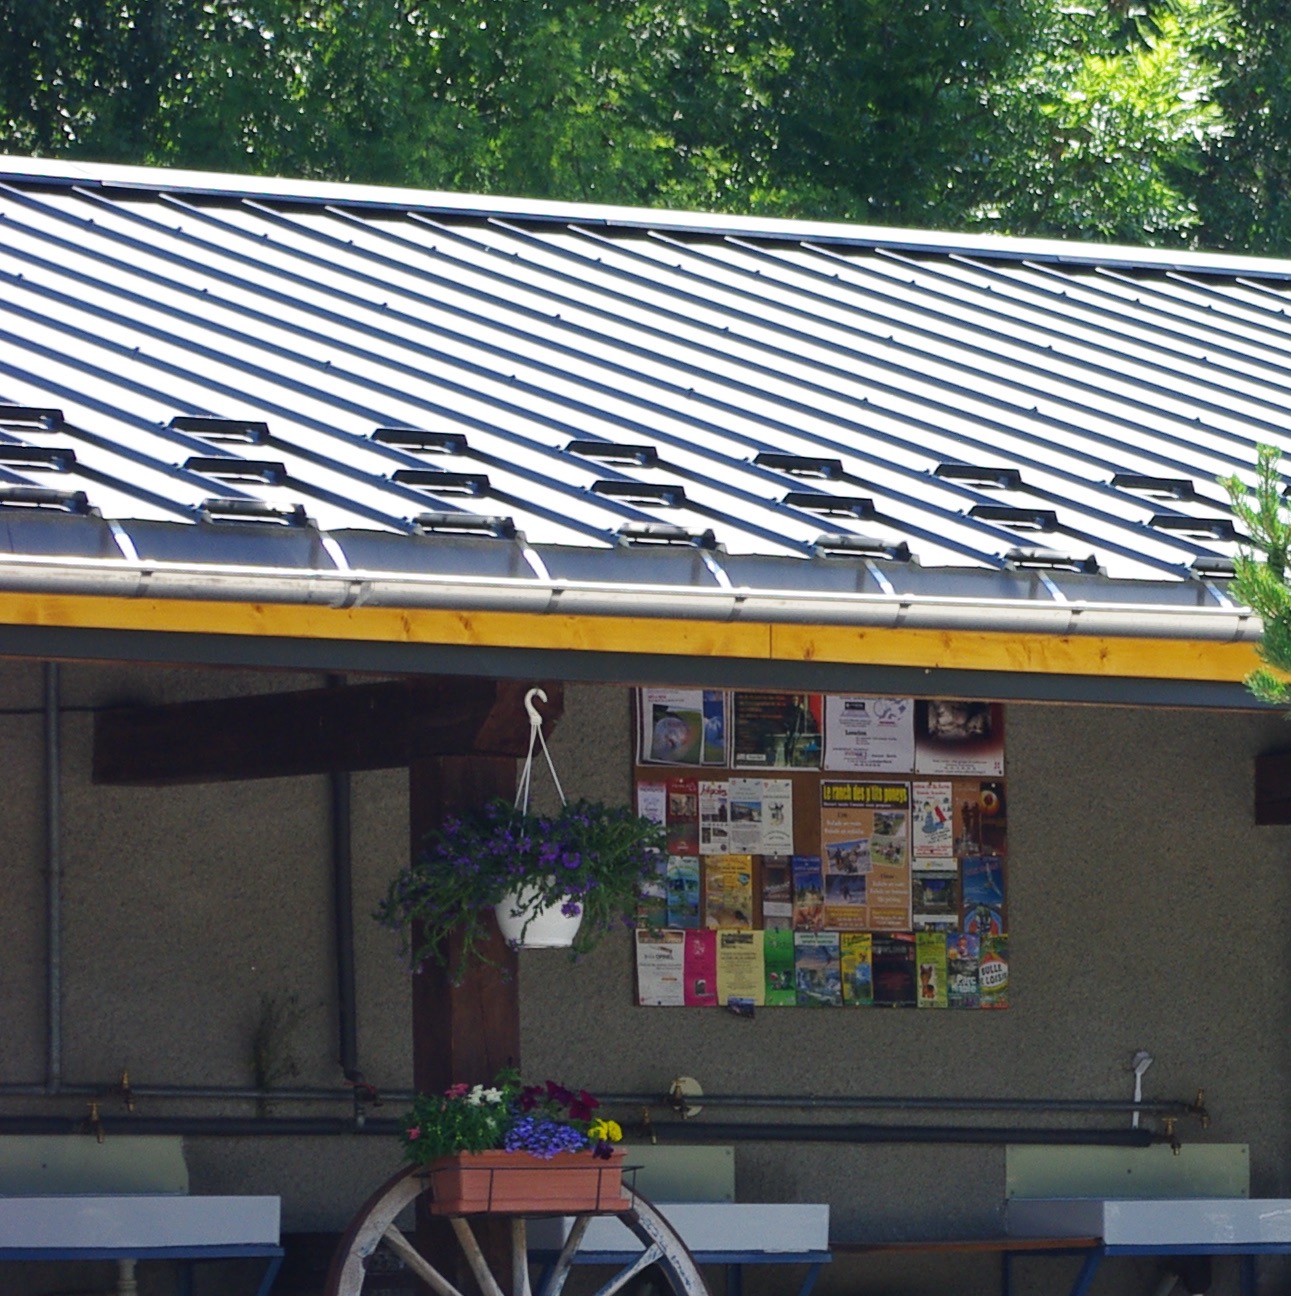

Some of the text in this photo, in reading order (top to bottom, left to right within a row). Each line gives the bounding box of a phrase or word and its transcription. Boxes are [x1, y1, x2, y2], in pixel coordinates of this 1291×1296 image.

[823, 785, 832, 801] Le
[832, 784, 852, 801] ranch
[853, 784, 865, 801] des
[884, 787, 908, 804] poneys
